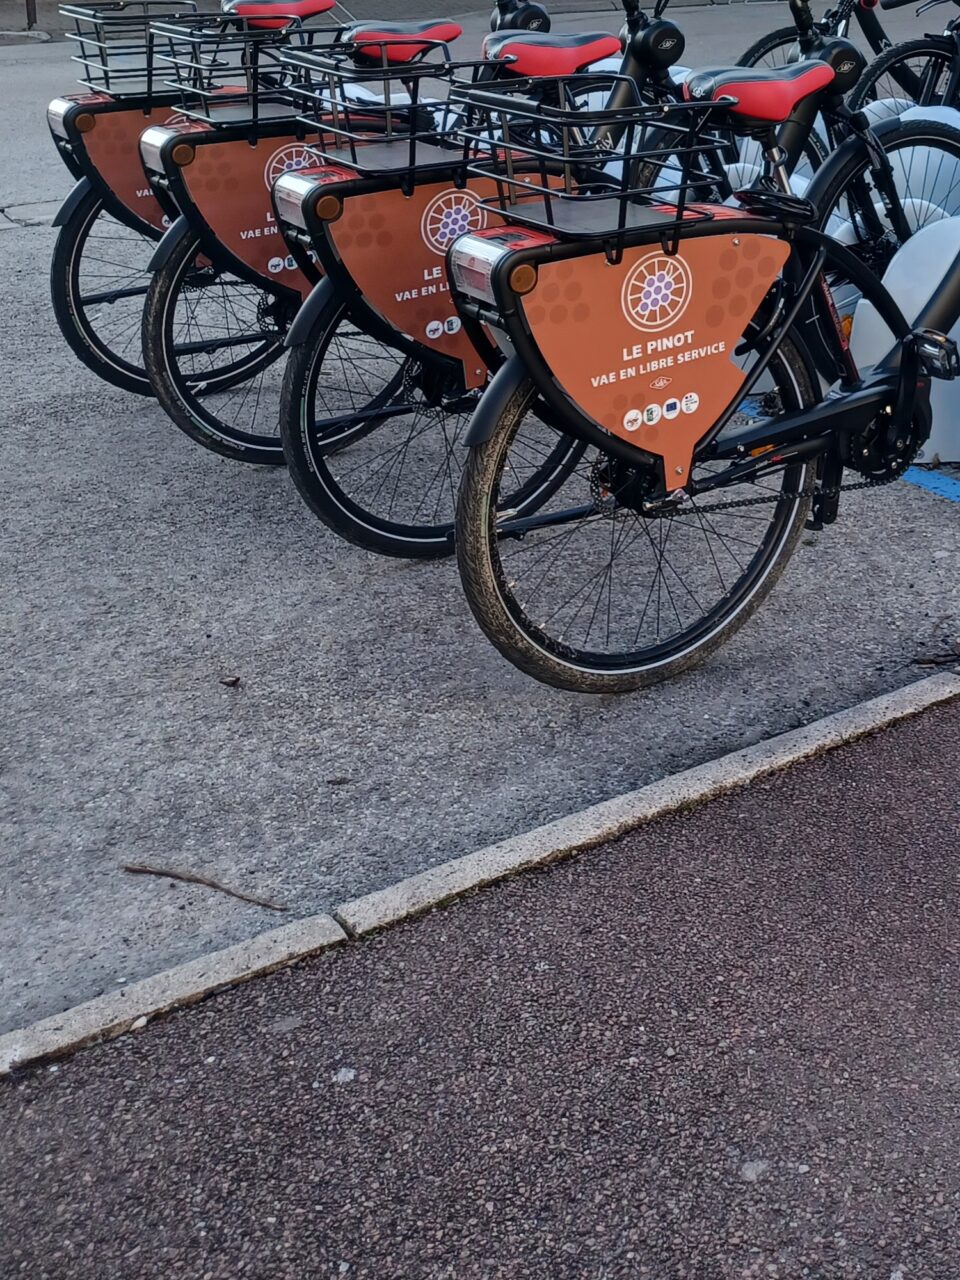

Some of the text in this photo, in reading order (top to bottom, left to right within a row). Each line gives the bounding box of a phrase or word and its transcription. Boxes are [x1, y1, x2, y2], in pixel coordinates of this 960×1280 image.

[266, 211, 276, 222] L
[240, 225, 278, 240] VAE EN
[424, 266, 443, 281] LE
[394, 289, 419, 302] VAE
[421, 284, 437, 297] EN
[622, 330, 695, 361] LE PINOT
[590, 341, 726, 388] VAE EN LIBRE SERVICE
